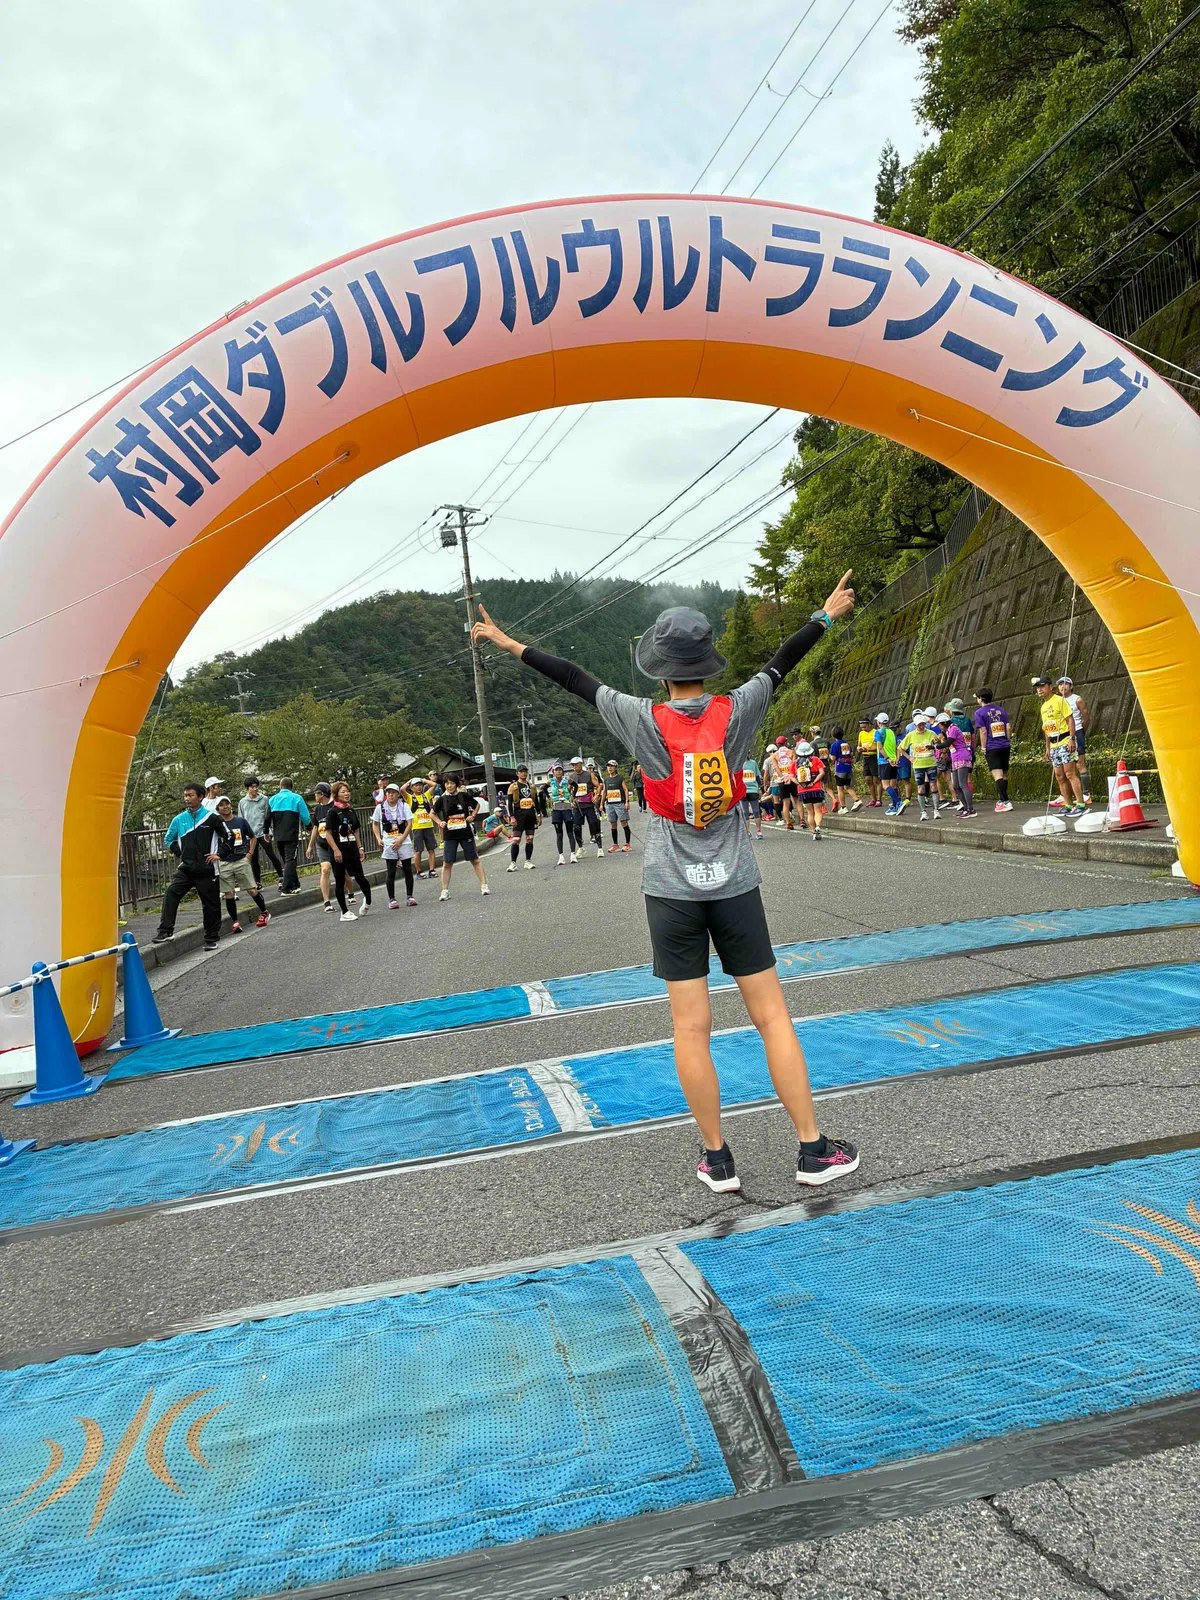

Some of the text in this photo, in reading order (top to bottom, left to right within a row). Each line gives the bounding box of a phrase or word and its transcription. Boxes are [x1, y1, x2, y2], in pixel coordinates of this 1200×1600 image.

[84, 215, 1149, 528] 村岡ダブルフルウルトラランニング
[699, 757, 725, 822] 08083
[685, 861, 728, 884] 酷道
